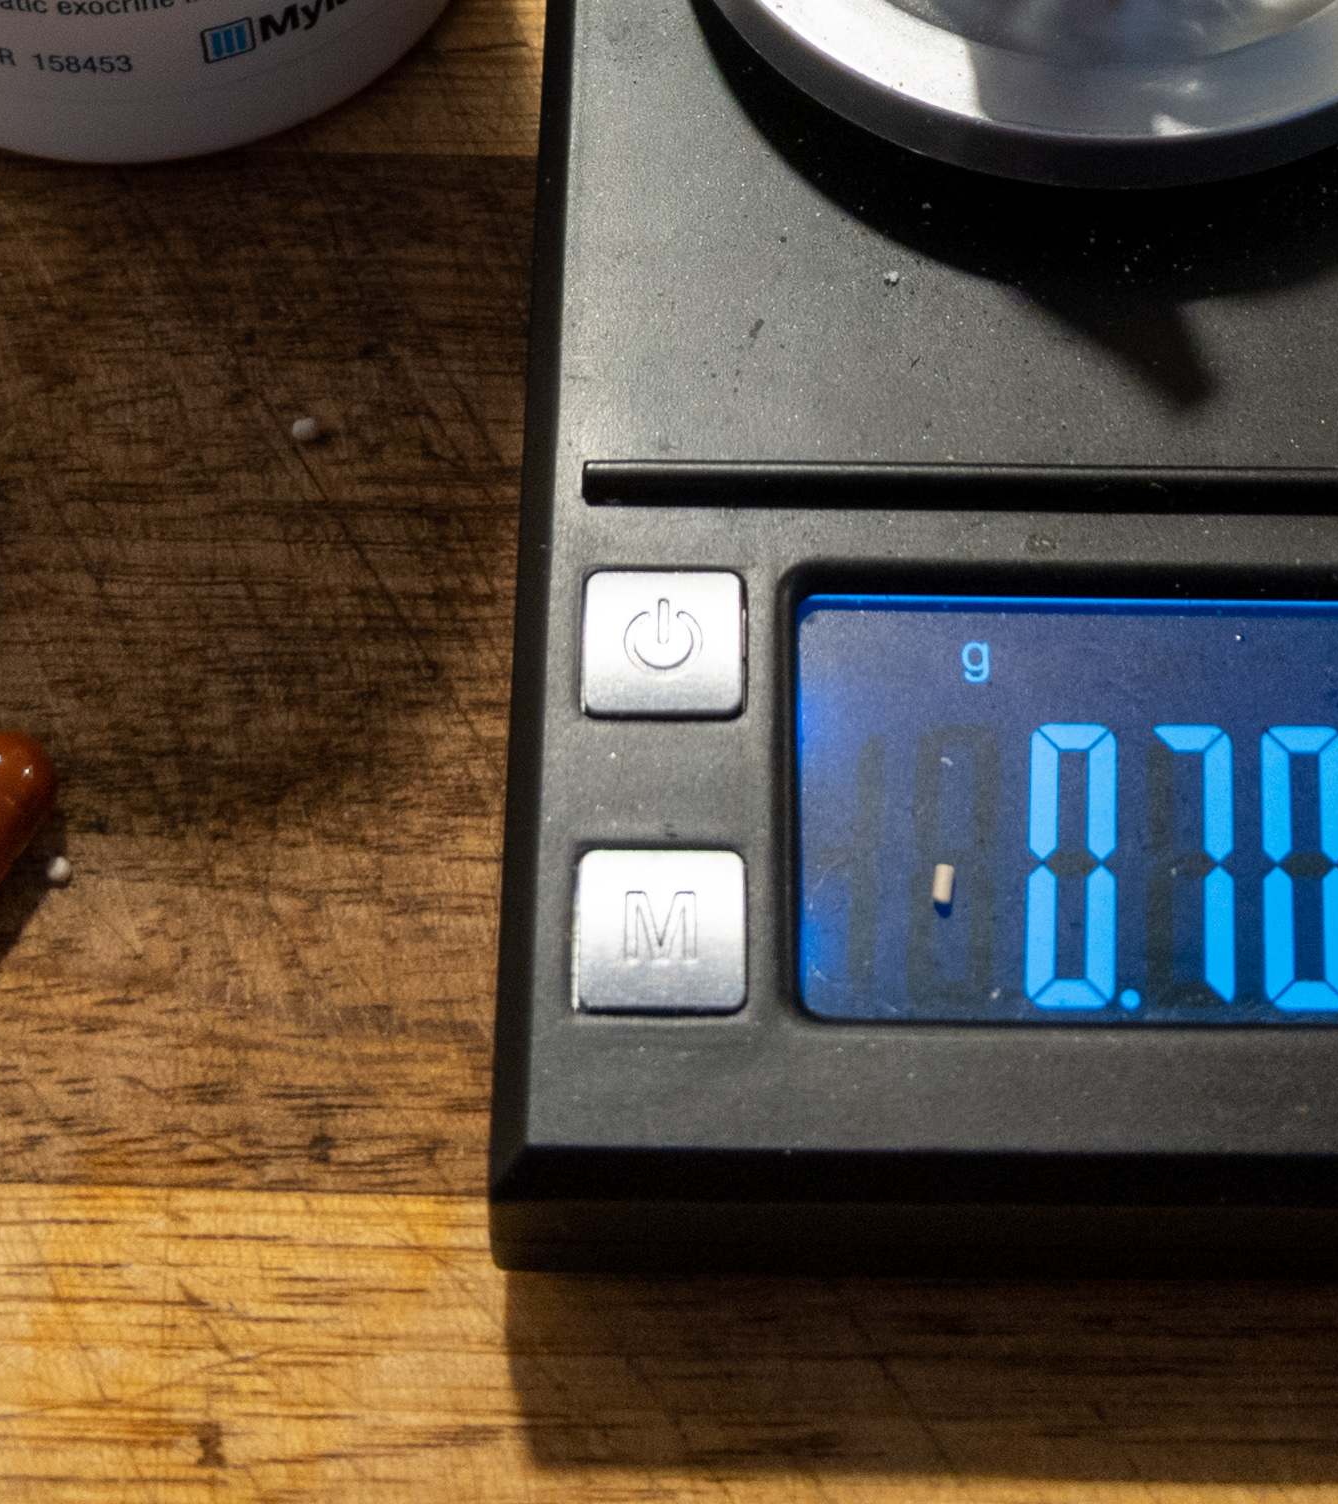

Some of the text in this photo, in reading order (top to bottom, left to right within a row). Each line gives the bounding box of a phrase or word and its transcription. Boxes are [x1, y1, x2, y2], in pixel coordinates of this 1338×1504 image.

[31, 53, 134, 74] 158453
[961, 641, 991, 684] g
[623, 890, 698, 964] M
